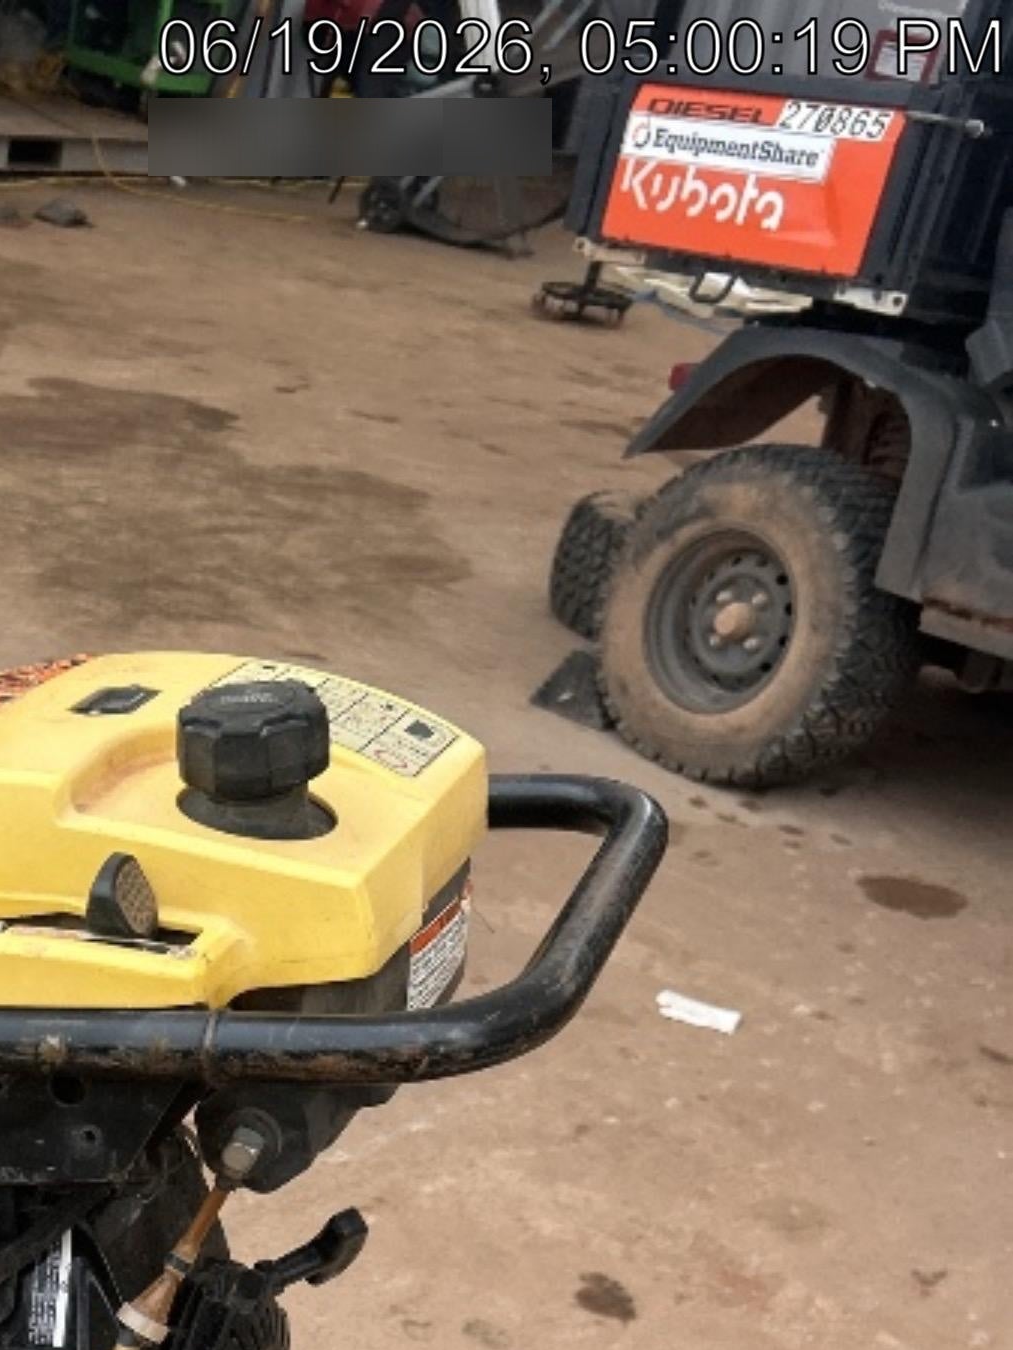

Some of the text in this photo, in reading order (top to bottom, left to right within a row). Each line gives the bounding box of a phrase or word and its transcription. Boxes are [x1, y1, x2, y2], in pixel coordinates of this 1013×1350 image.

[648, 97, 765, 125] DIESEL
[779, 99, 888, 139] 270865
[653, 126, 821, 168] EquipmentShare
[620, 158, 785, 232] Kubota
